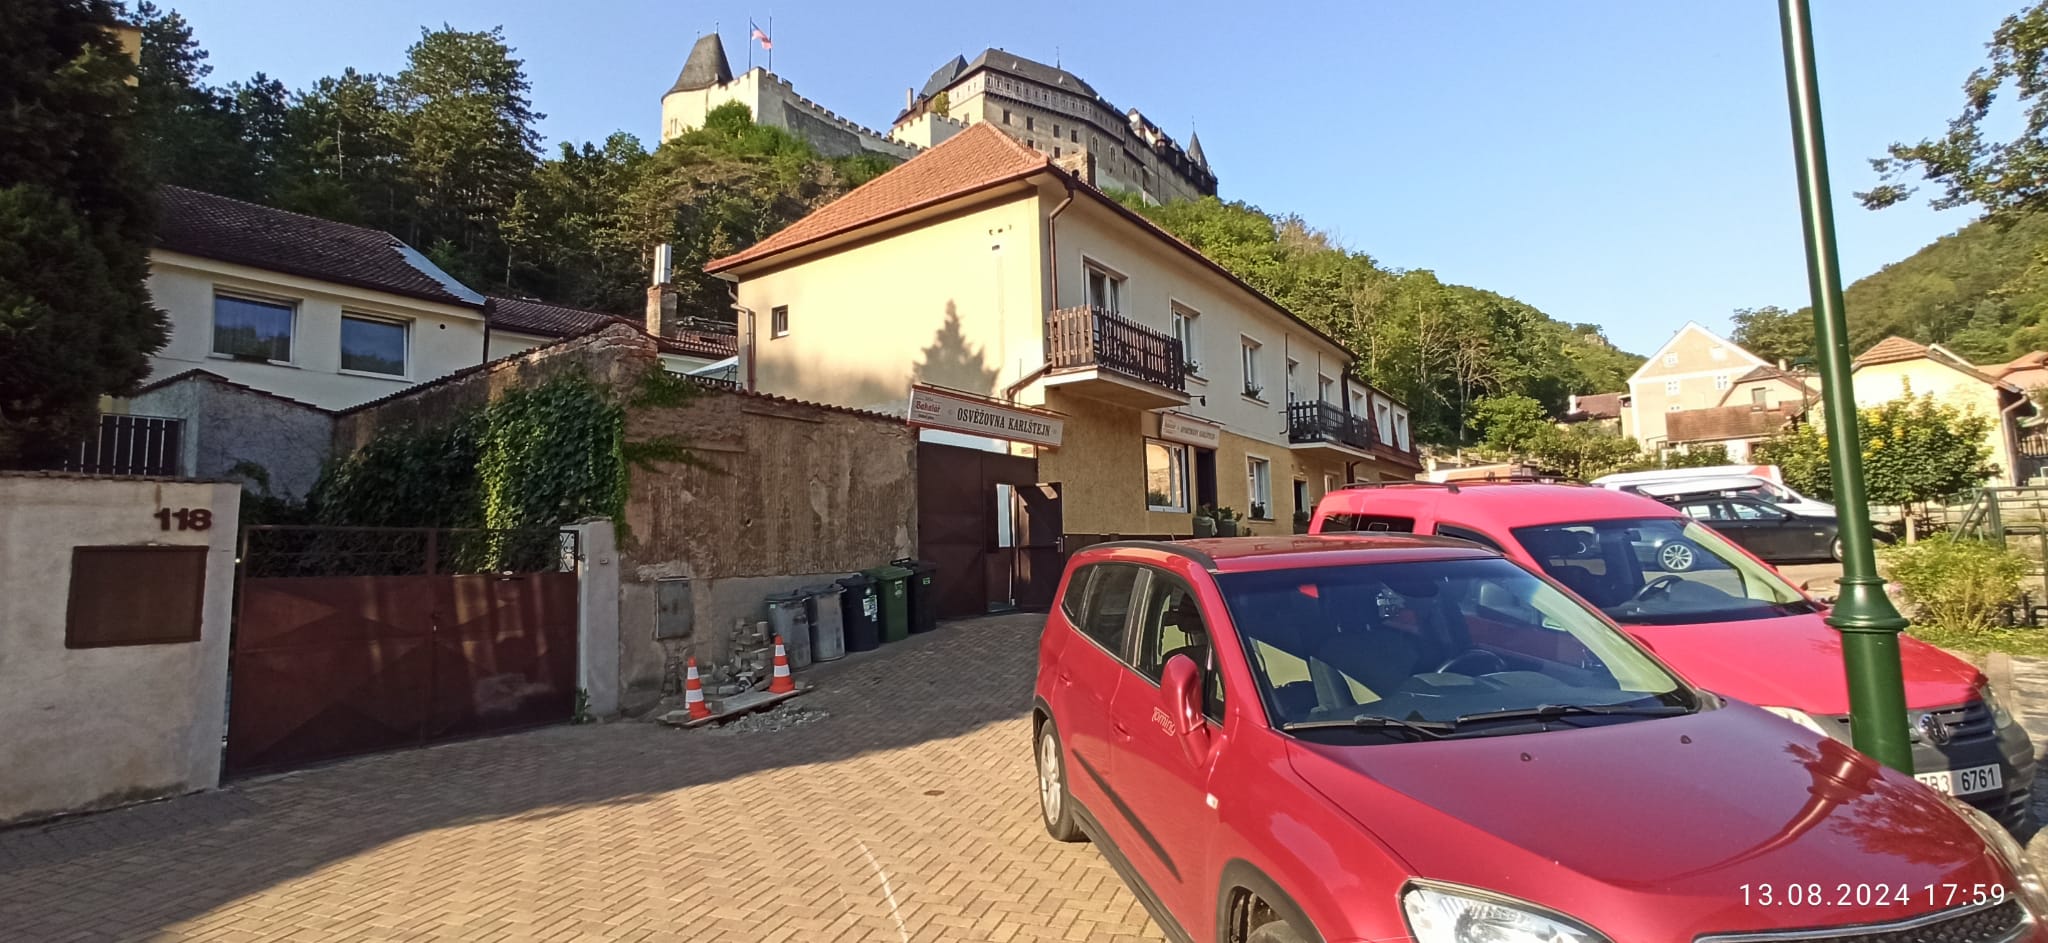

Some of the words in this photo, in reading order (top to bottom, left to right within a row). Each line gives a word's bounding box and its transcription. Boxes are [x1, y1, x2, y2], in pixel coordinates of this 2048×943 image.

[957, 407, 1005, 429] OSVĚŽOVNA
[1008, 420, 1051, 436] KARLŠTEJN
[153, 508, 212, 531] 118
[1961, 767, 1995, 791] 6761
